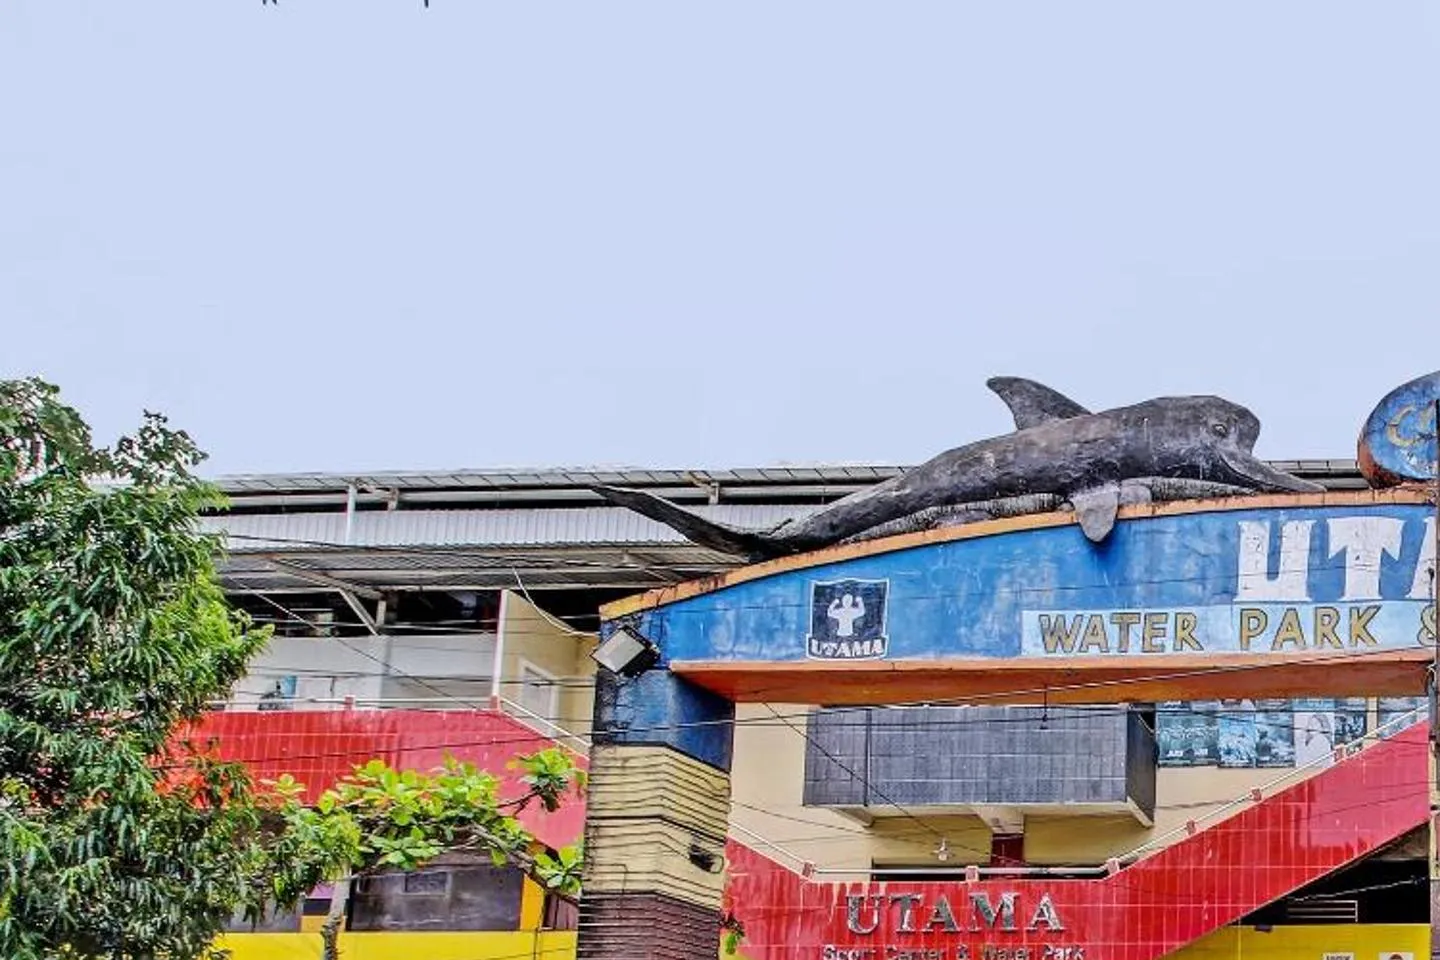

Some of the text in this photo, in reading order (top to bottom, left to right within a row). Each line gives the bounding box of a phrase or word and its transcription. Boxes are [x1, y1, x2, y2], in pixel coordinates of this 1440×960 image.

[811, 638, 884, 658] UTAMA
[1038, 612, 1204, 654] WATER
[1239, 604, 1381, 651] PARK
[845, 892, 1065, 935] UTAMA
